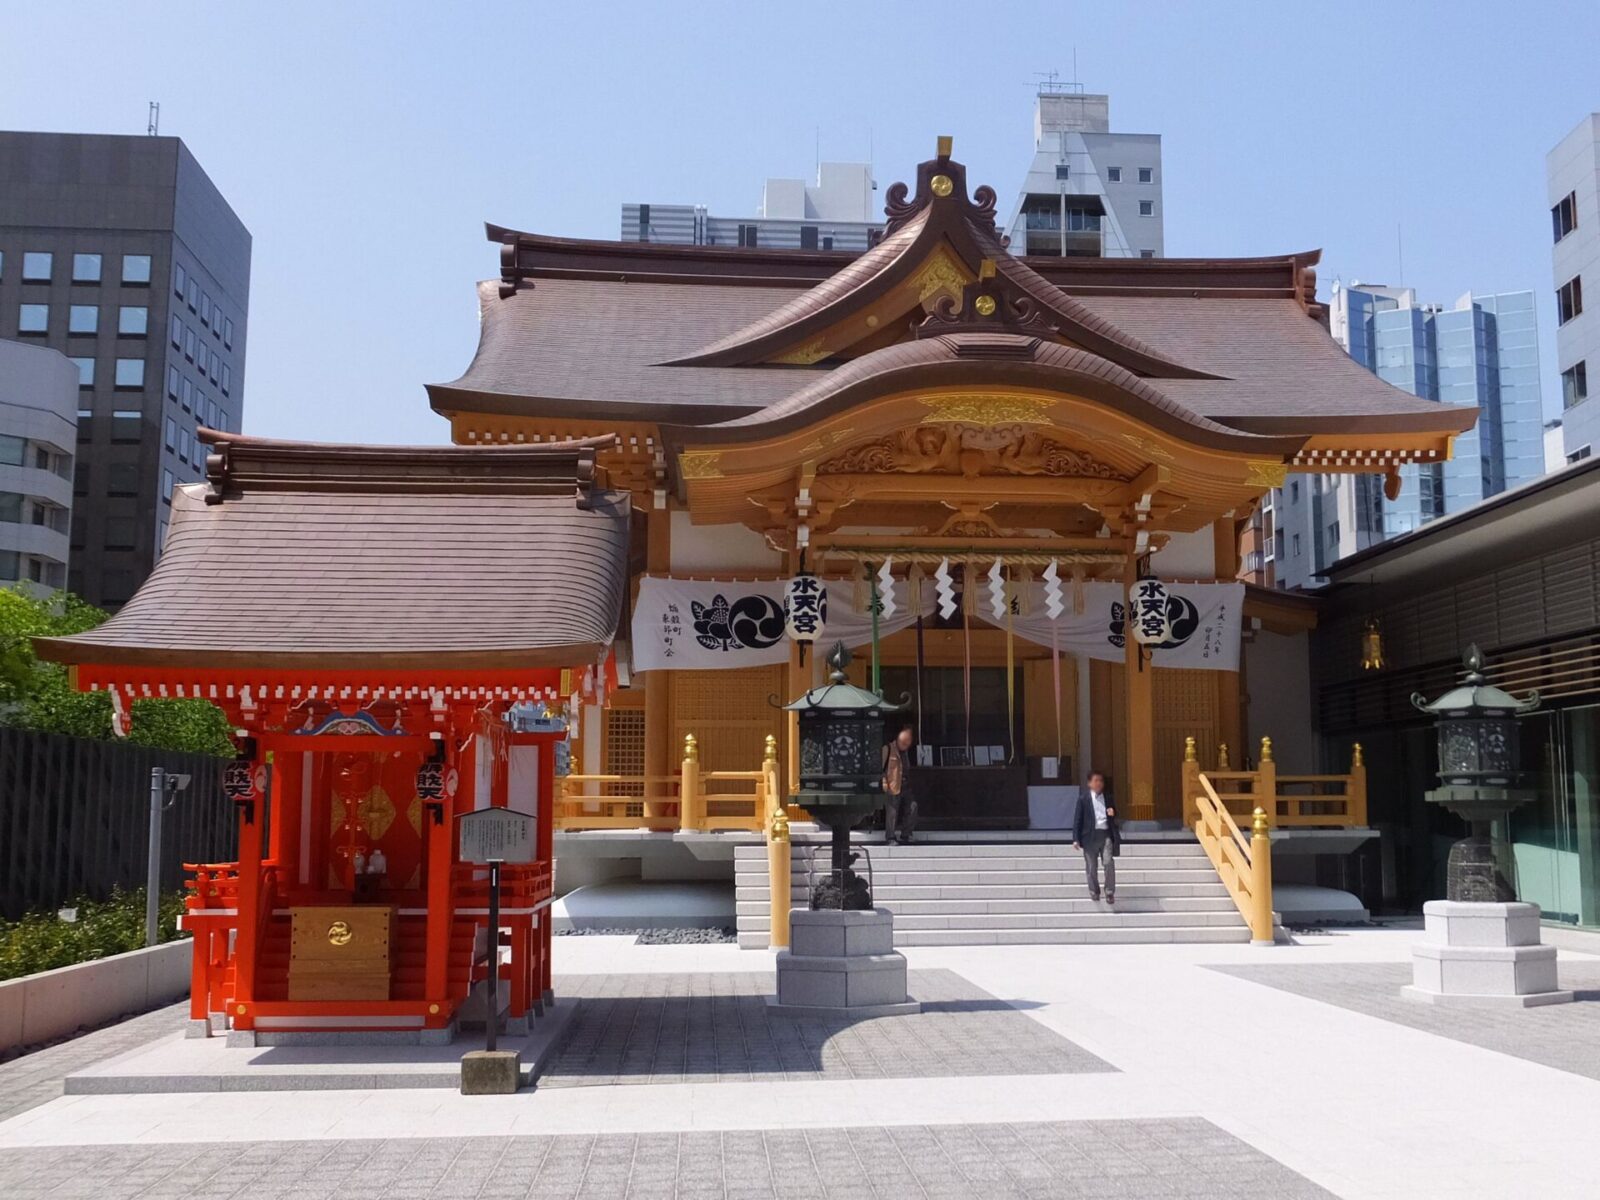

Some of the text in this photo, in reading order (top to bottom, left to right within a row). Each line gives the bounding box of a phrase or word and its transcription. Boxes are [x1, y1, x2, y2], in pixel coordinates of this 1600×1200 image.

[791, 578, 819, 633] 水天宮
[1138, 582, 1166, 637] 水天宮
